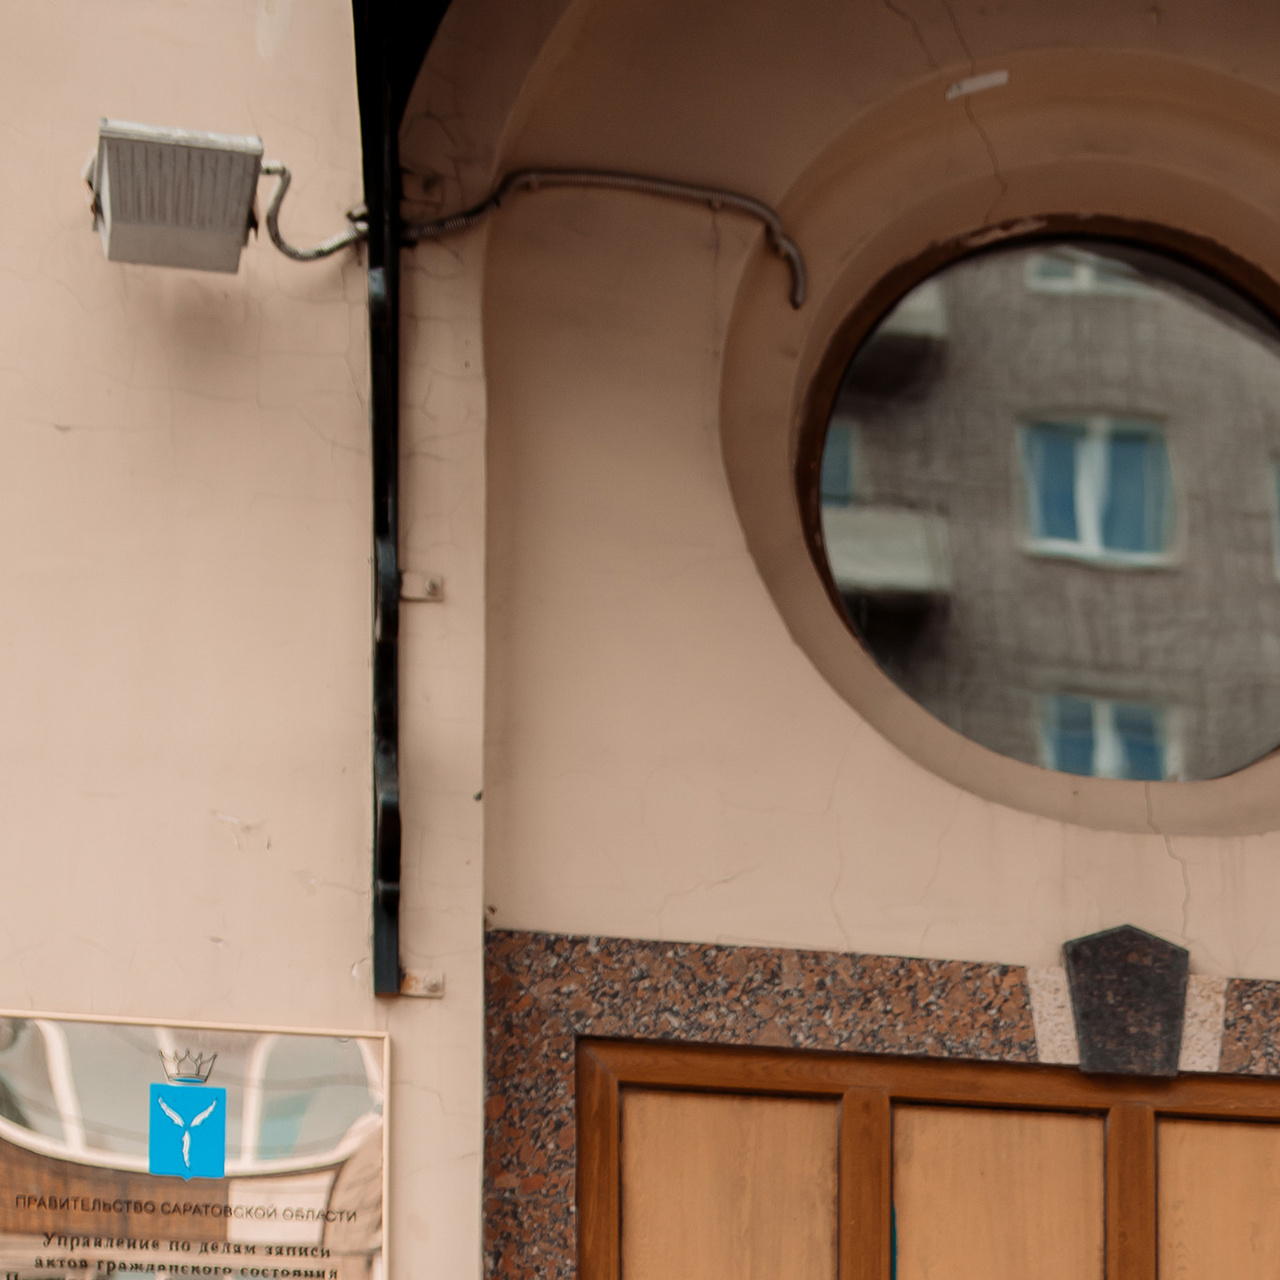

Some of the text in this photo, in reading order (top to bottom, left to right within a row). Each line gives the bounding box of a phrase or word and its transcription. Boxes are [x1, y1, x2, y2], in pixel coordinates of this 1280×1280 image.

[15, 1194, 358, 1223] ПРАВИТЕЛЬСТВО САРАТОВСКОЙ ОБЛАСТИ
[43, 1232, 331, 1258] Управление по делам записи
[34, 1256, 338, 1280] актов гражданского состояния
